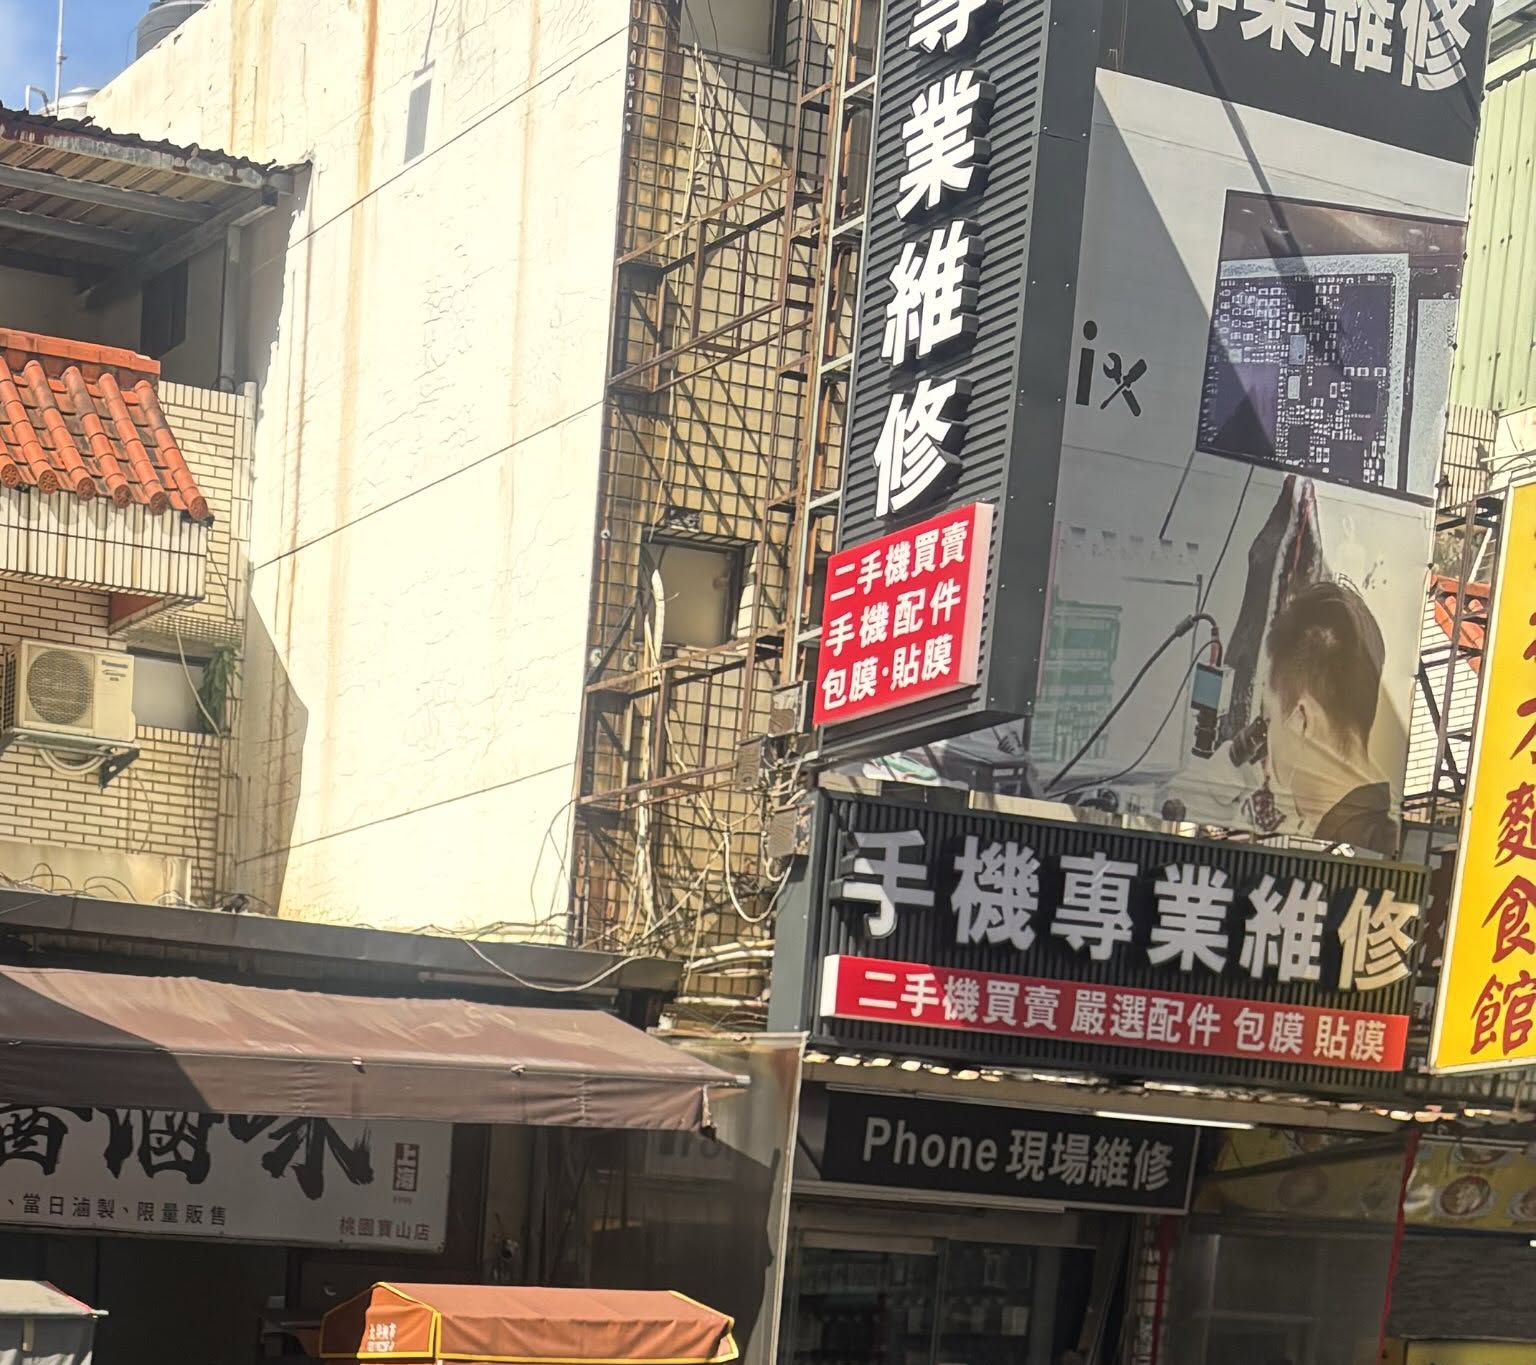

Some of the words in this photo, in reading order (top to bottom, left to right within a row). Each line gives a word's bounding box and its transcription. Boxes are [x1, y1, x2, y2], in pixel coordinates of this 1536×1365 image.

[1176, 0, 1471, 91] 業維修
[830, 520, 969, 602] 二手機買賣
[825, 578, 961, 657] 手機配件
[842, 829, 1420, 991] 手機專業維修
[859, 970, 1060, 1033] 二手機買賣
[1070, 989, 1221, 1048] 嚴選配件
[1234, 1008, 1305, 1055] 包膜
[1313, 1016, 1386, 1064] 貼膜
[864, 1117, 997, 1172] Phone
[1008, 1128, 1173, 1193] 現場維修
